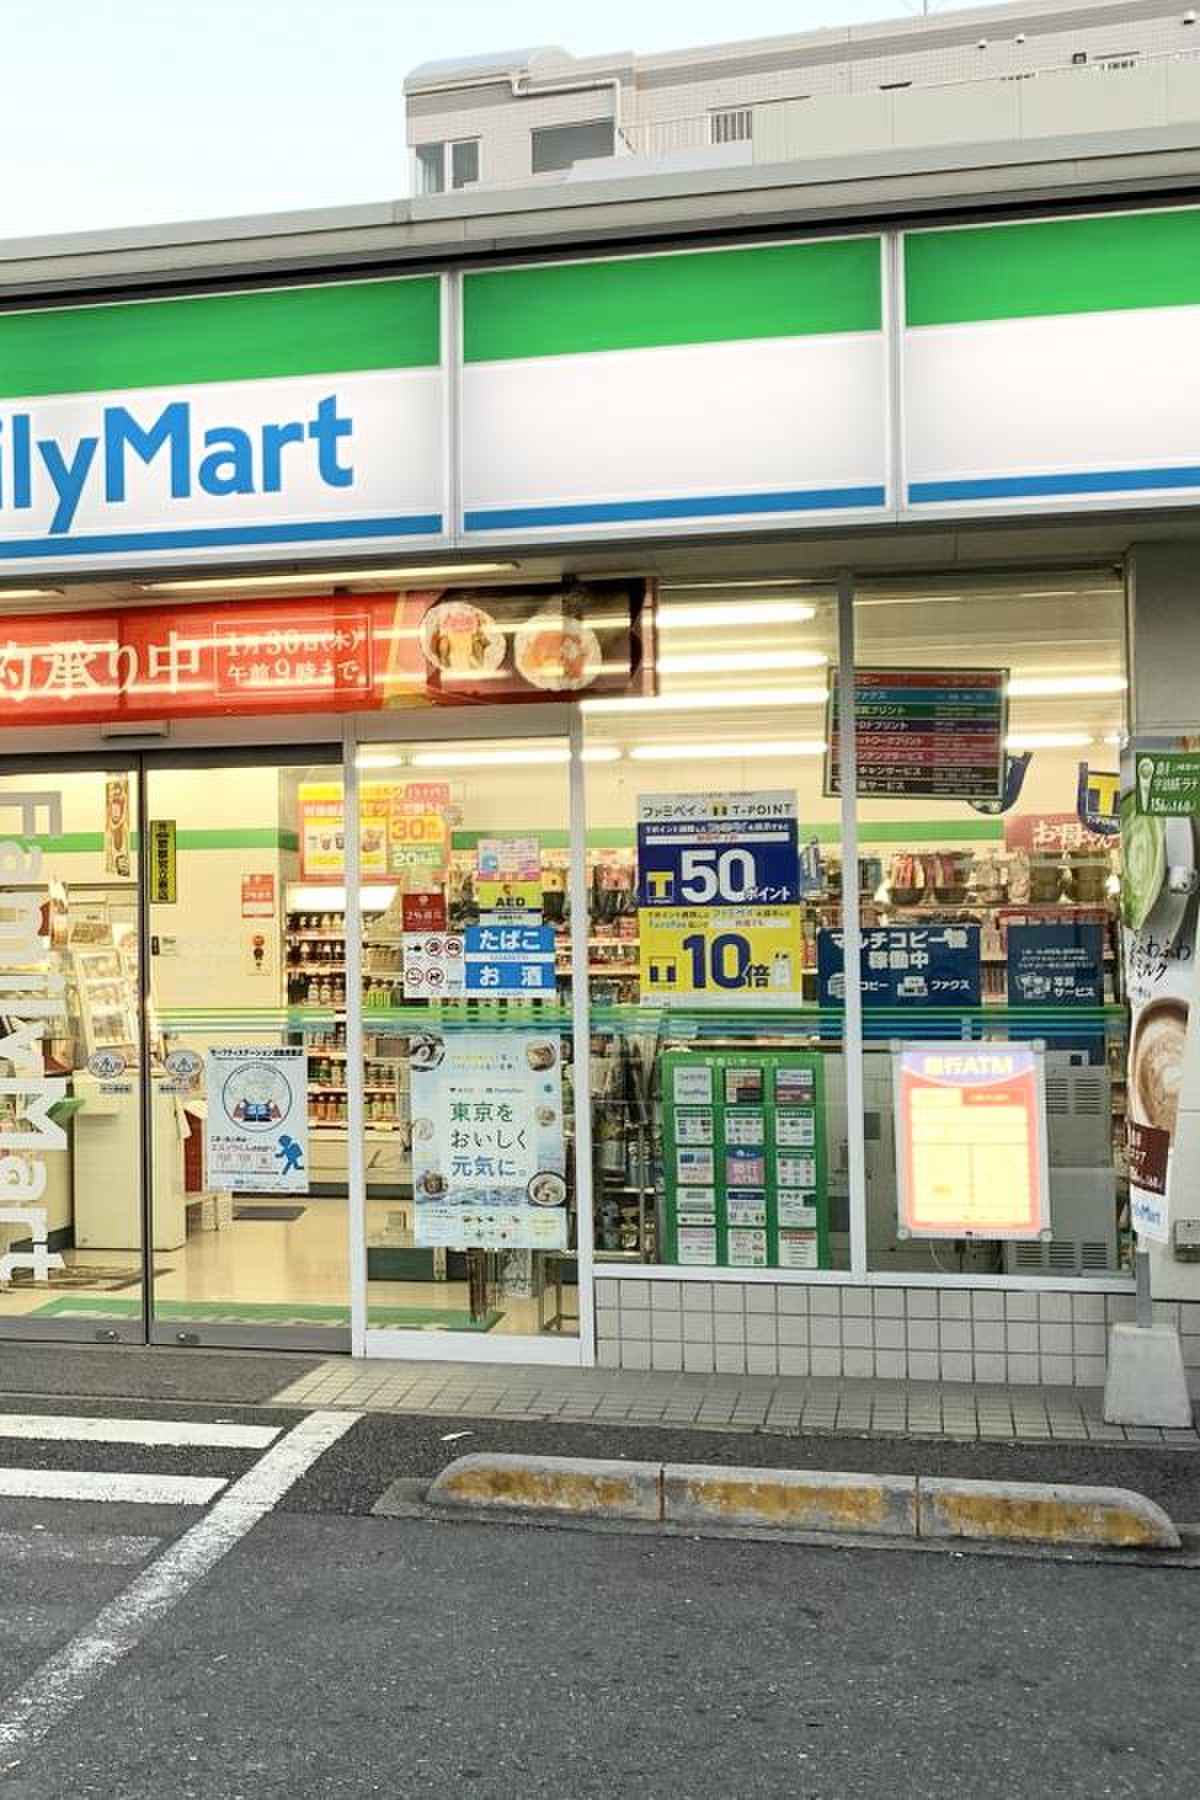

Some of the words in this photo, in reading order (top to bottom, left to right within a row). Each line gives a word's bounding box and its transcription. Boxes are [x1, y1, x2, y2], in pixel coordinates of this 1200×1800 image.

[642, 804, 697, 817] ファミペイ
[733, 803, 793, 816] T-POINT
[681, 848, 756, 903] 50
[496, 897, 526, 908] AED
[480, 929, 541, 950] たばこ
[682, 933, 751, 989] 10
[746, 963, 771, 988] 倍
[931, 978, 971, 991] ファクス
[449, 1102, 513, 1123] 東京を
[451, 1129, 528, 1150] おいしく
[451, 1156, 527, 1177] 元気に。
